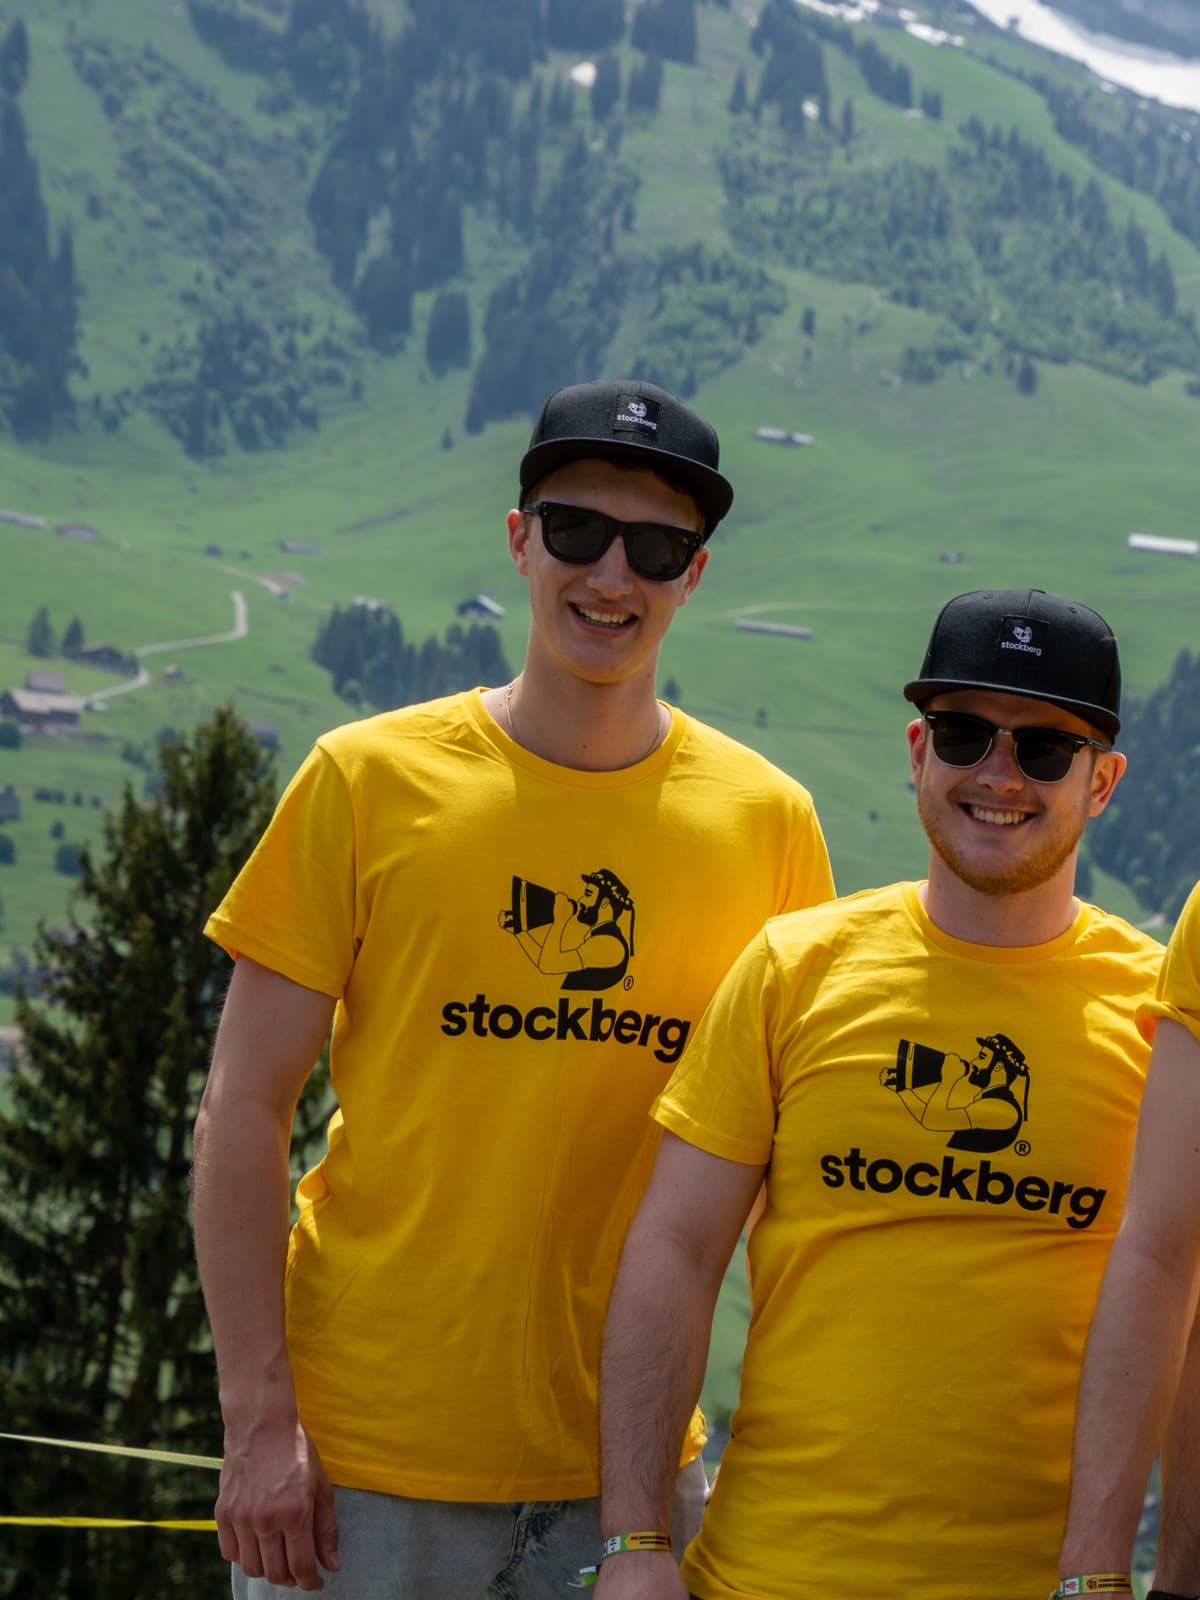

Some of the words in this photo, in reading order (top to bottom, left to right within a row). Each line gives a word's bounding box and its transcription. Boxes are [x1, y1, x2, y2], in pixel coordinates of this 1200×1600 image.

[1001, 641, 1042, 656] stockberg
[440, 994, 691, 1064] stockberg
[820, 1148, 1107, 1229] stockberg
